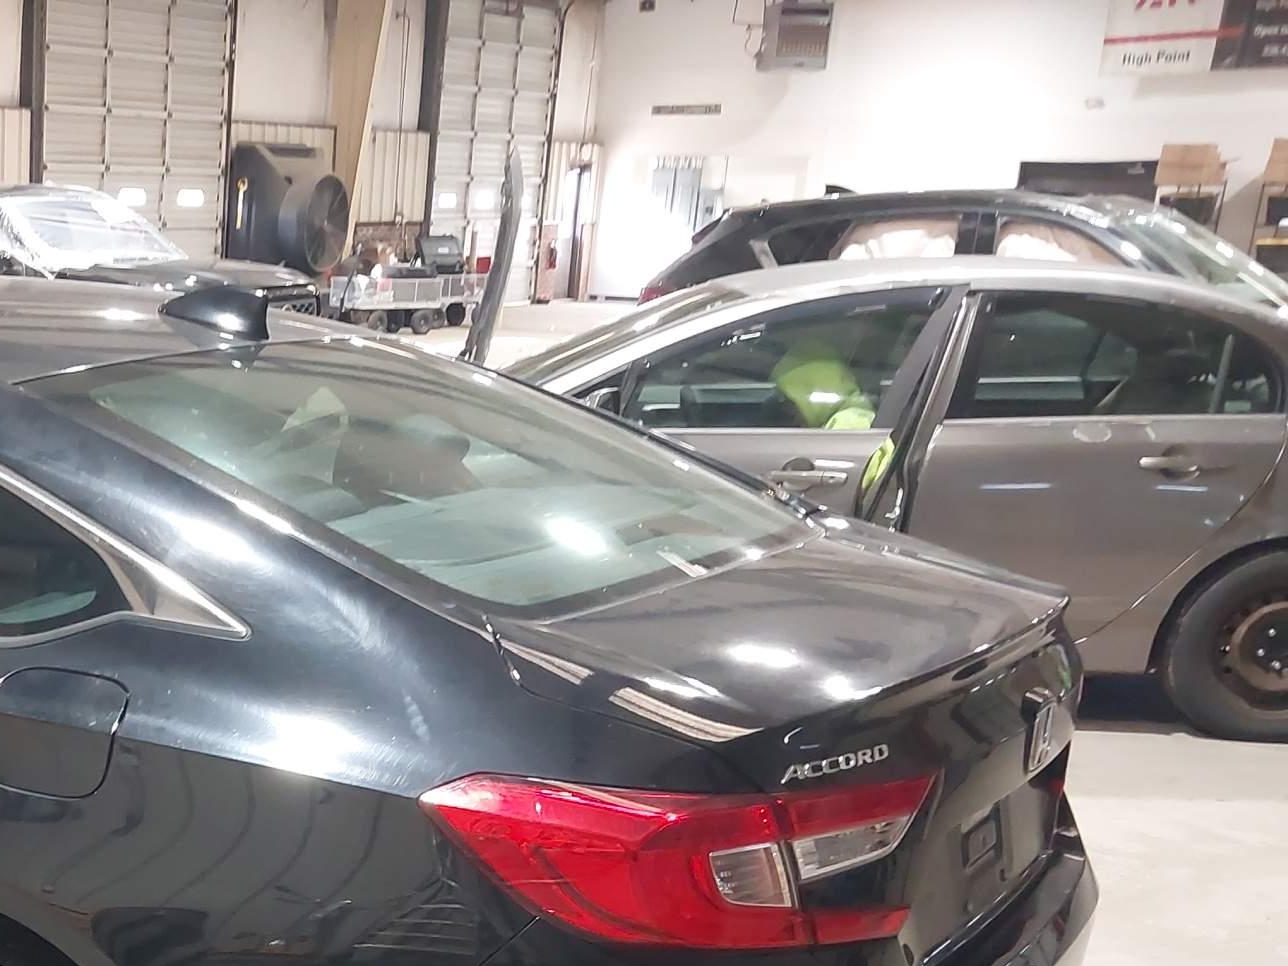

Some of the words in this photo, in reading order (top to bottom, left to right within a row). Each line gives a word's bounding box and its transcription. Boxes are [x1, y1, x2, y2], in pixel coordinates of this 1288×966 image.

[1122, 52, 1152, 67] High
[1156, 49, 1191, 64] Point
[780, 743, 890, 784] ACCORD
